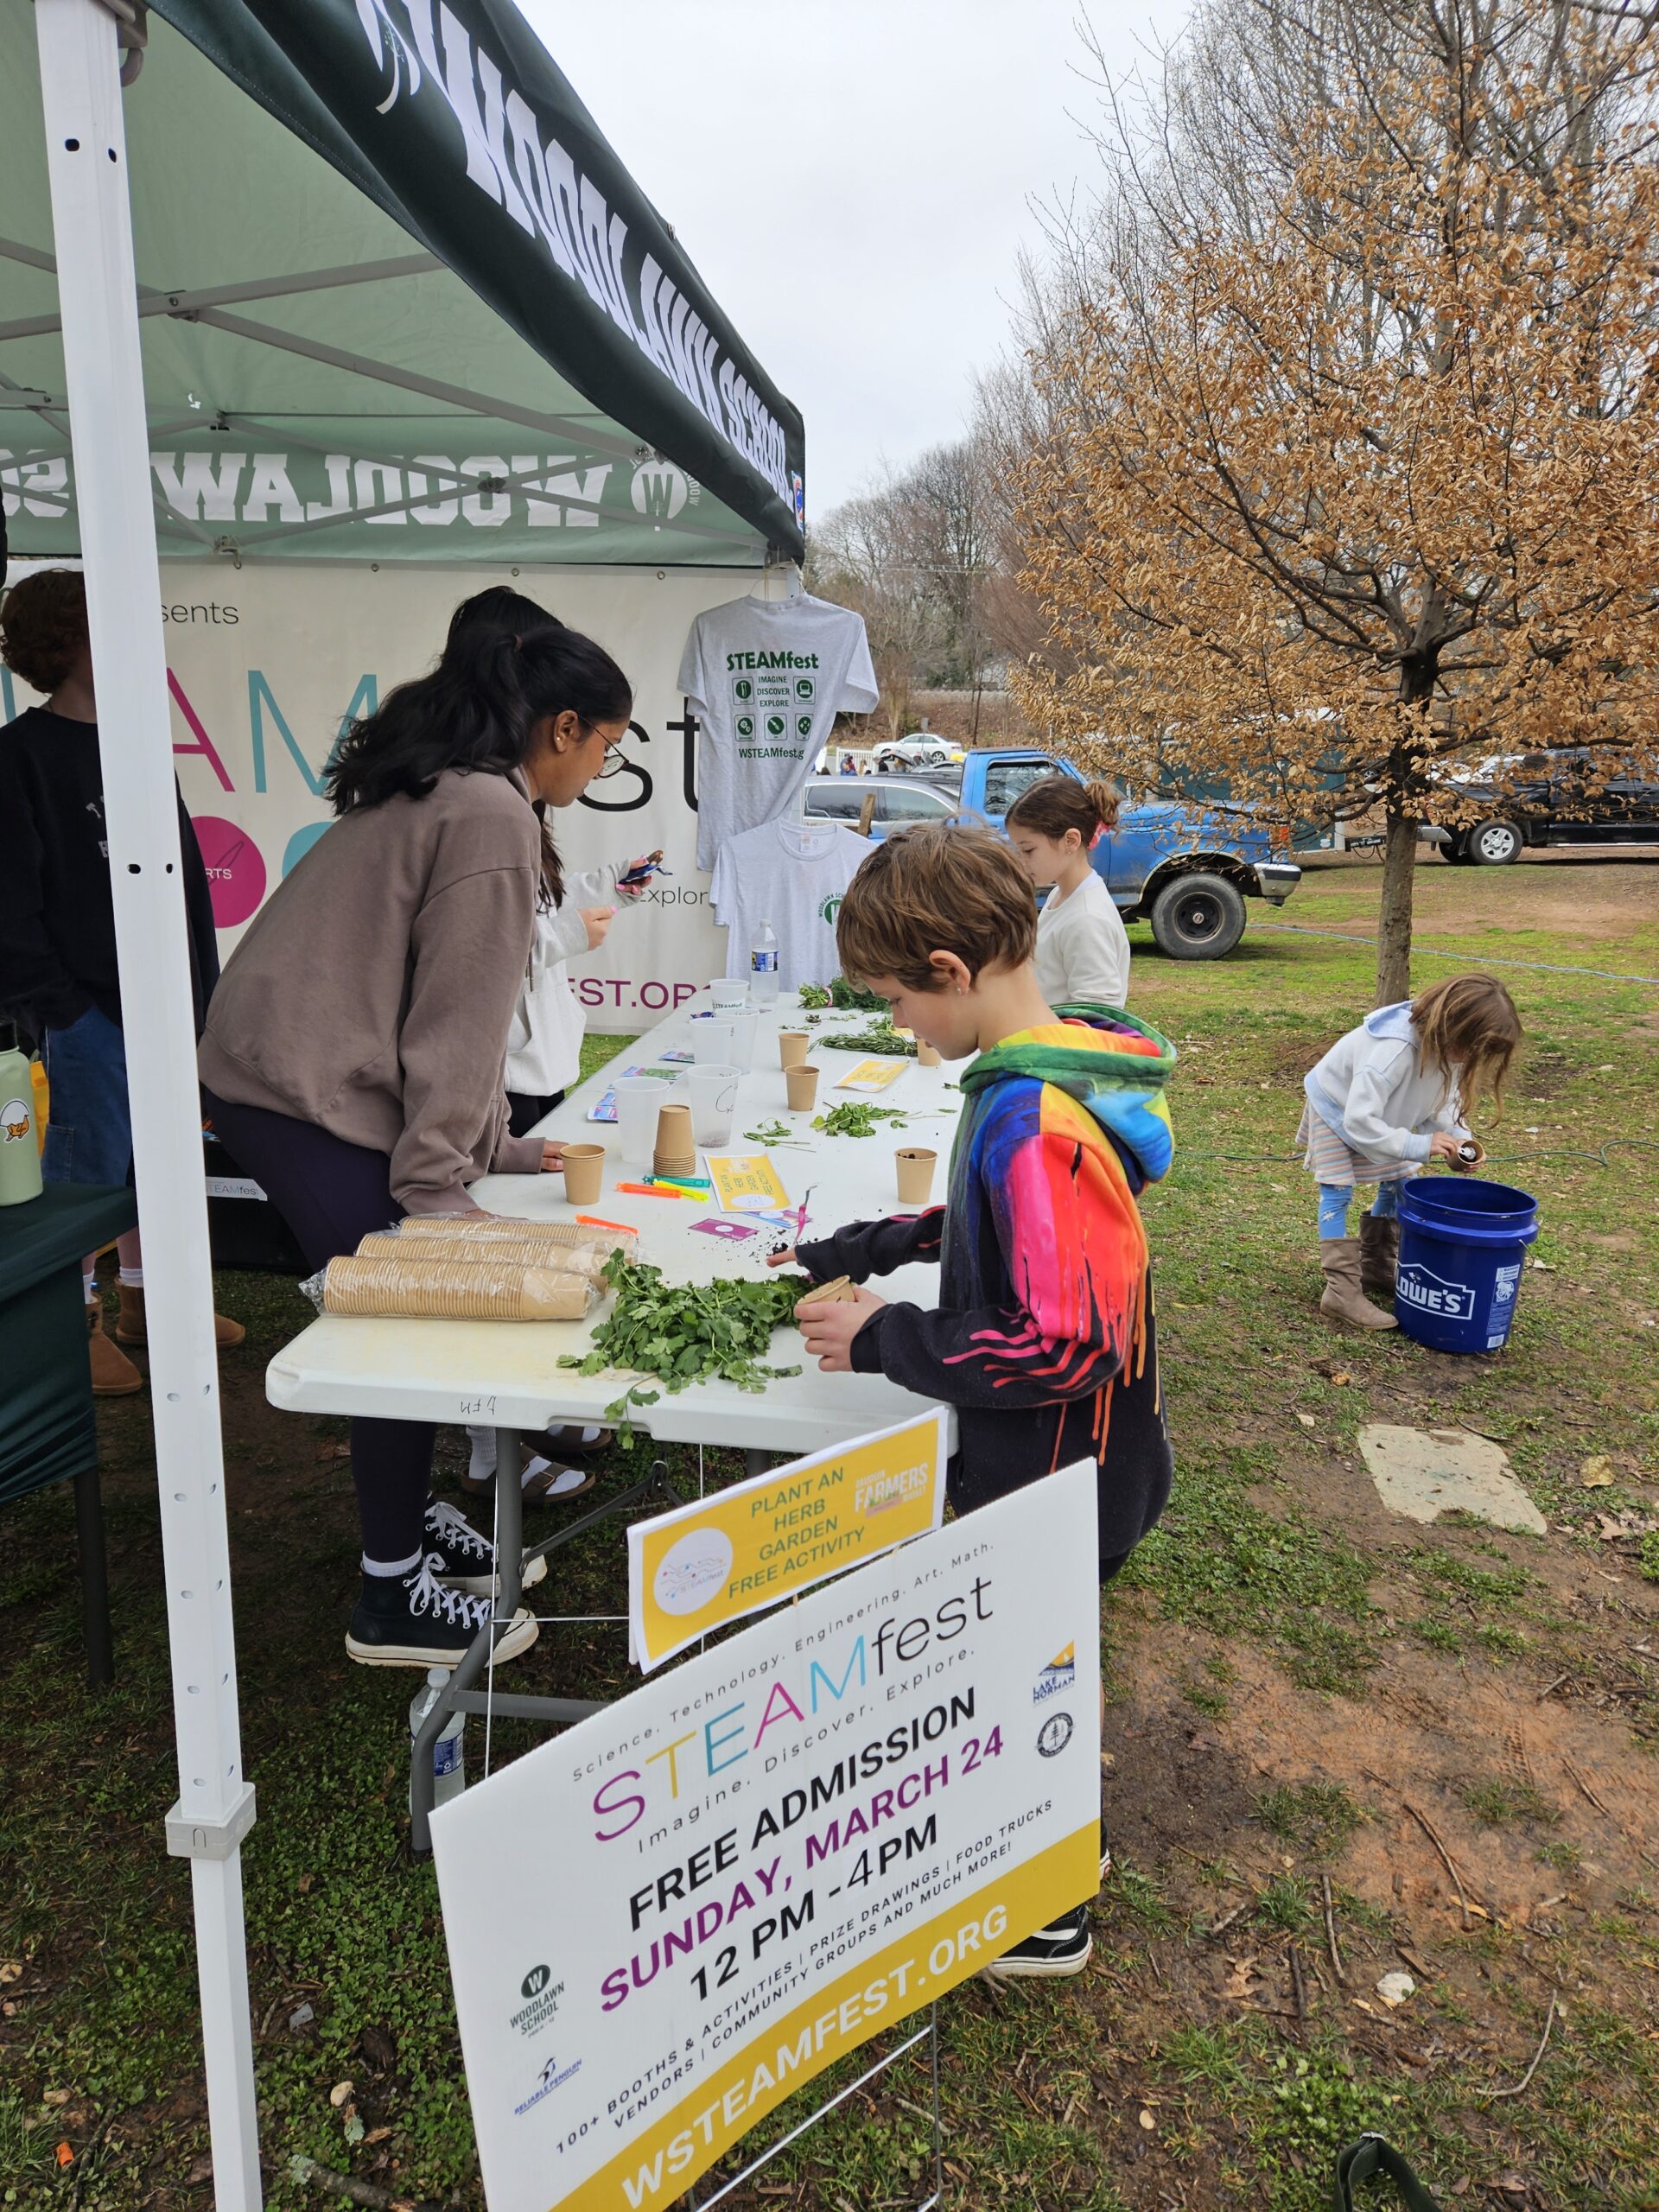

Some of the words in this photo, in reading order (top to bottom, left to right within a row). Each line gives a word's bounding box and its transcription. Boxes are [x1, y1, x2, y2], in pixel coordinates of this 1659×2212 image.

[719, 358, 795, 514] SCHOOL
[161, 601, 239, 625] sents
[727, 651, 819, 671] STEAMfest
[739, 747, 804, 760] WSTEAMfest.g
[205, 868, 232, 880] RTS
[640, 886, 709, 908] xplor
[1395, 1268, 1462, 1313] LOWE'S
[751, 1480, 813, 1518] PLANT
[817, 1466, 844, 1491] AN
[855, 1462, 928, 1513] FARMERS
[759, 1516, 838, 1561] GARDEN
[774, 1499, 825, 1533] HERB
[729, 1565, 779, 1599] FREE
[783, 1527, 865, 1575] ACTIVITY
[573, 1728, 660, 1781] Science.
[670, 1654, 785, 1723] Technology.
[795, 1589, 906, 1652] Engineering.
[913, 1567, 944, 1588] Art.
[951, 1541, 994, 1568] Math.
[1033, 1675, 1058, 1695] LAKE
[593, 1577, 993, 1841] STEAMfest
[1033, 1673, 1075, 1704] NORMAN
[638, 1779, 751, 1853] Imagine.
[765, 1706, 874, 1773] Discover.
[887, 1649, 975, 1701] Explore.
[629, 1827, 740, 1932] FREE
[751, 1687, 975, 1851] ADMISSION
[601, 1856, 793, 2012] SUNDAY,
[805, 1755, 949, 1870] MARCH
[961, 1725, 1003, 1777] 24
[690, 1945, 740, 2001] 12
[752, 1890, 815, 1961] PM
[556, 2116, 600, 2154] 100+
[607, 2050, 677, 2114] BOOTHS
[684, 2037, 695, 2052] &
[702, 1961, 792, 2038] ACTIVITIES
[810, 1918, 855, 1957] PRIZE
[861, 1867, 940, 1922] DRAWINGS
[956, 1835, 993, 1865] FOOD
[998, 1800, 1052, 1838] TRUCKS
[613, 2058, 694, 2128] VENDORS
[712, 1968, 809, 2049] COMMUNITY
[816, 1925, 877, 1970] GROUPS
[883, 1902, 914, 1927] AND
[919, 1872, 962, 1904] MUCH
[968, 1841, 1012, 1875] MORE!
[510, 1981, 564, 2029] WOODLAWN
[521, 2000, 559, 2036] SCHOOL
[621, 1904, 1008, 2209] WSTEAMFEST.ORG
[514, 2084, 549, 2115] RELIABLE
[549, 2058, 582, 2088] PENGUIN
